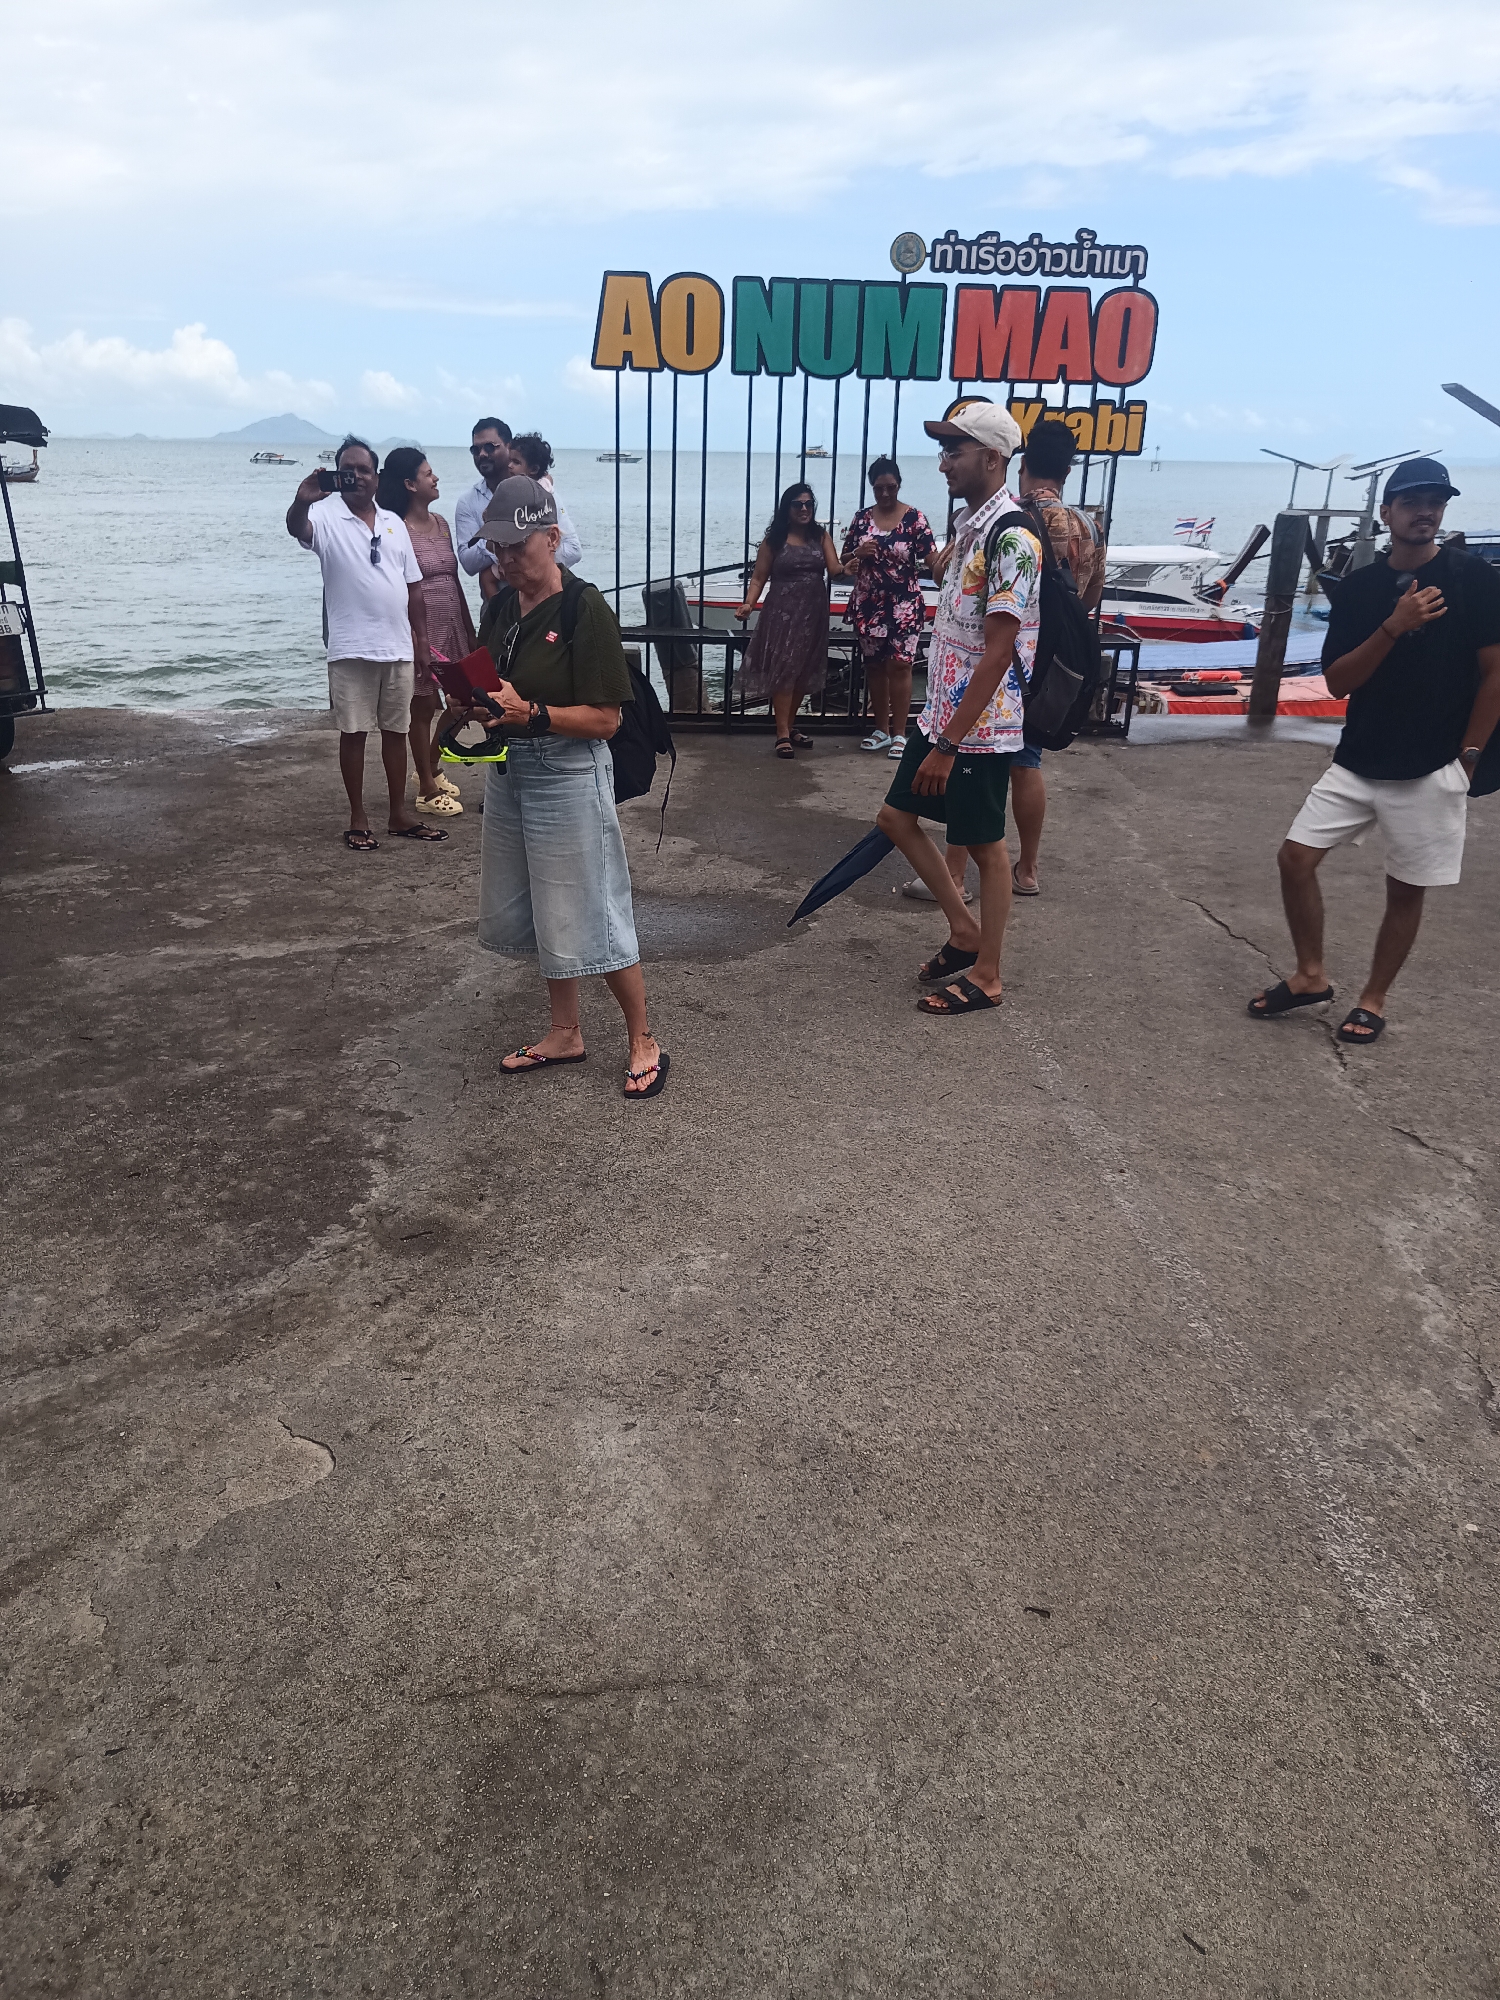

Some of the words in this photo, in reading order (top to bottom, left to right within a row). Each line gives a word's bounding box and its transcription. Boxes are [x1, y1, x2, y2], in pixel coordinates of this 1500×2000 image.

[933, 232, 1145, 277] ท่าเรืออ่าวน้ำเมา
[593, 271, 723, 374] AO
[732, 276, 946, 380] NUM
[950, 284, 1158, 386] MAO
